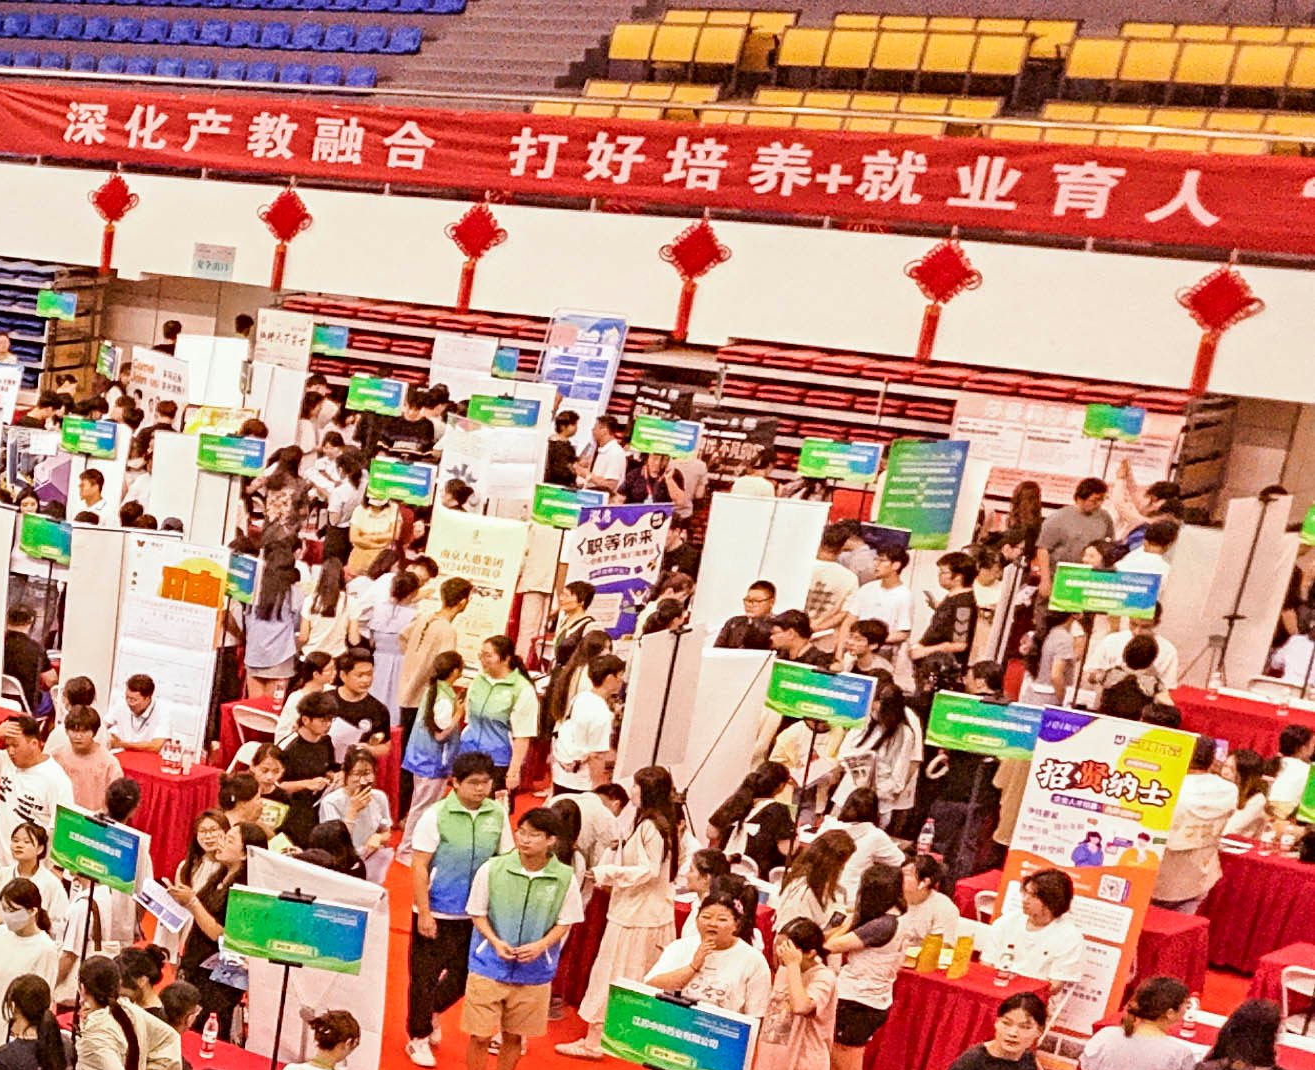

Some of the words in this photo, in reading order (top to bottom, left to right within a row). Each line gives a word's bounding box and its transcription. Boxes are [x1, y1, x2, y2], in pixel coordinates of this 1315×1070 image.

[62, 101, 436, 171] 深化产教融合
[510, 126, 1221, 228] 打好培养+就业育人
[587, 530, 653, 556] 职等你来
[1037, 760, 1172, 807] 招贤纳士
